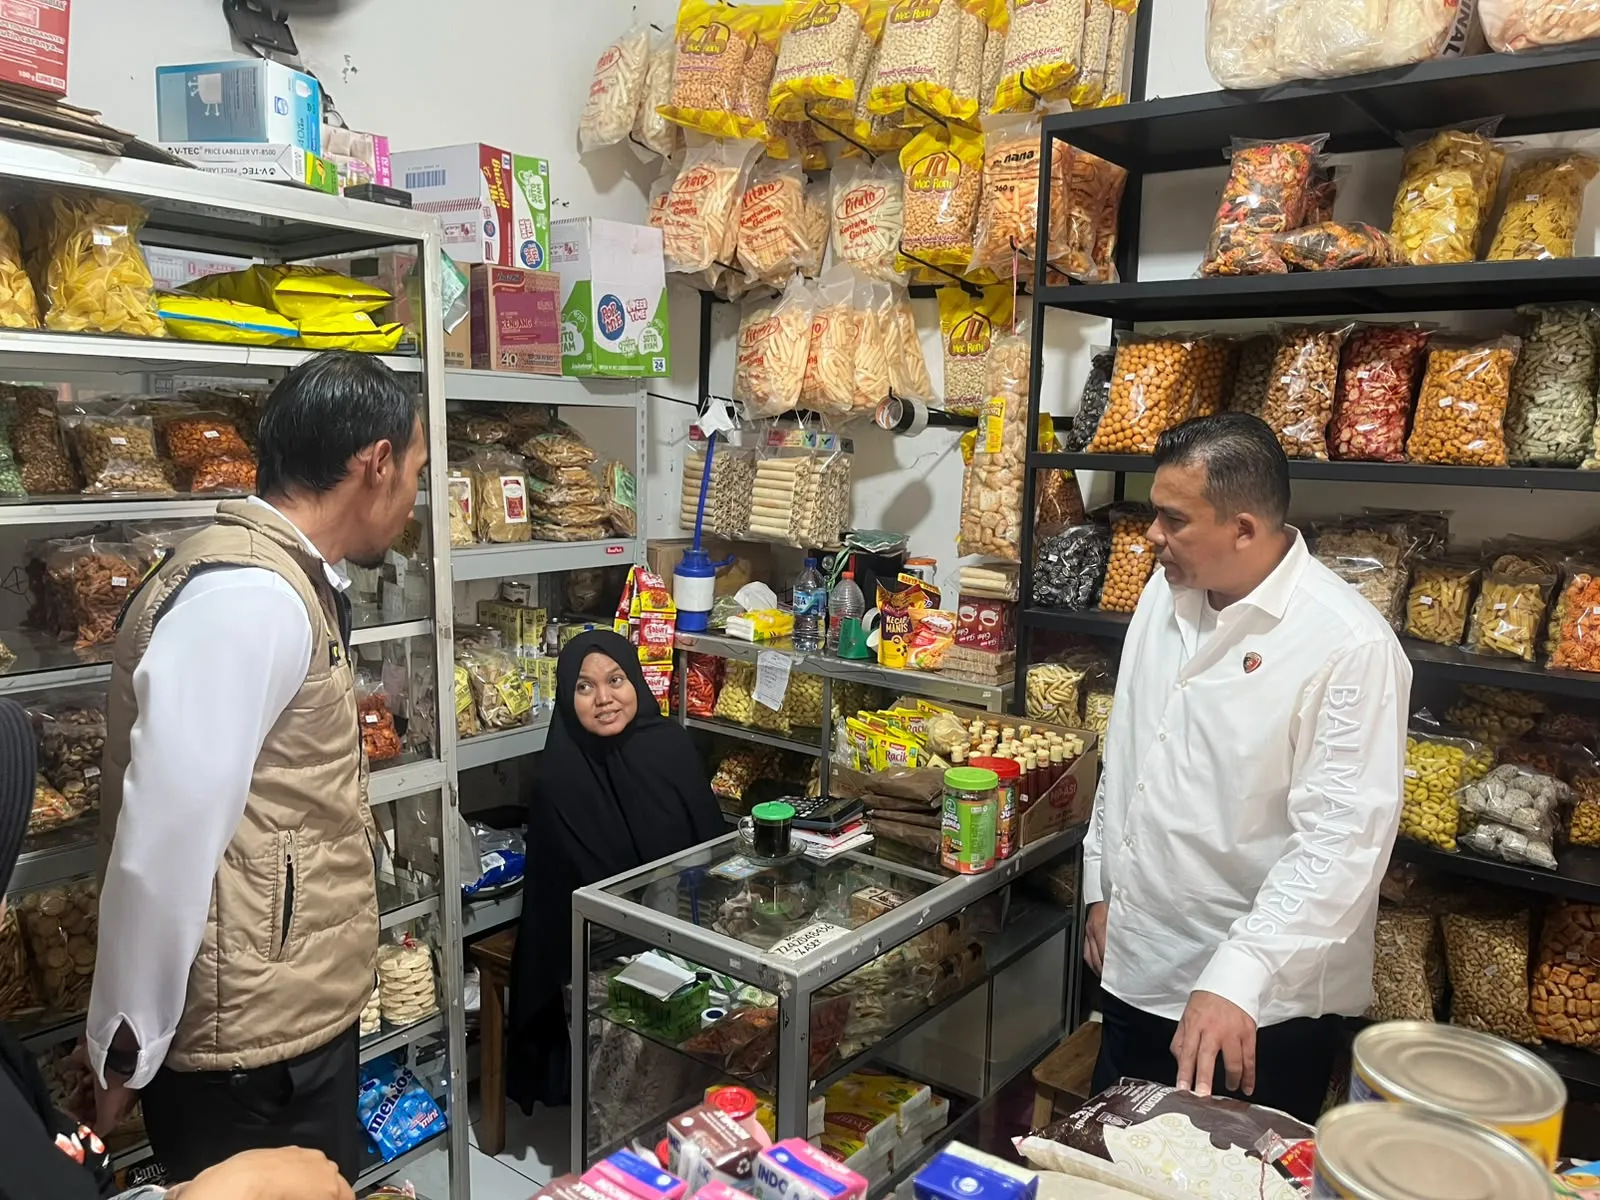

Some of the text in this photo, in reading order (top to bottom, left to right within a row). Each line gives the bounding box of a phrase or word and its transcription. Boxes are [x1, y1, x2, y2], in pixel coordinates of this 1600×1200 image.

[174, 147, 276, 156] V-TEC PRICE LABELLER VT-8500
[242, 167, 268, 175] V-TEC
[914, 178, 930, 189] Mac
[885, 615, 907, 625] KECAP
[885, 623, 909, 633] MANIS
[886, 750, 907, 763] Racik
[1244, 848, 1334, 937] PARIS
[367, 1067, 413, 1136] mentos
[420, 1108, 439, 1129] mint
